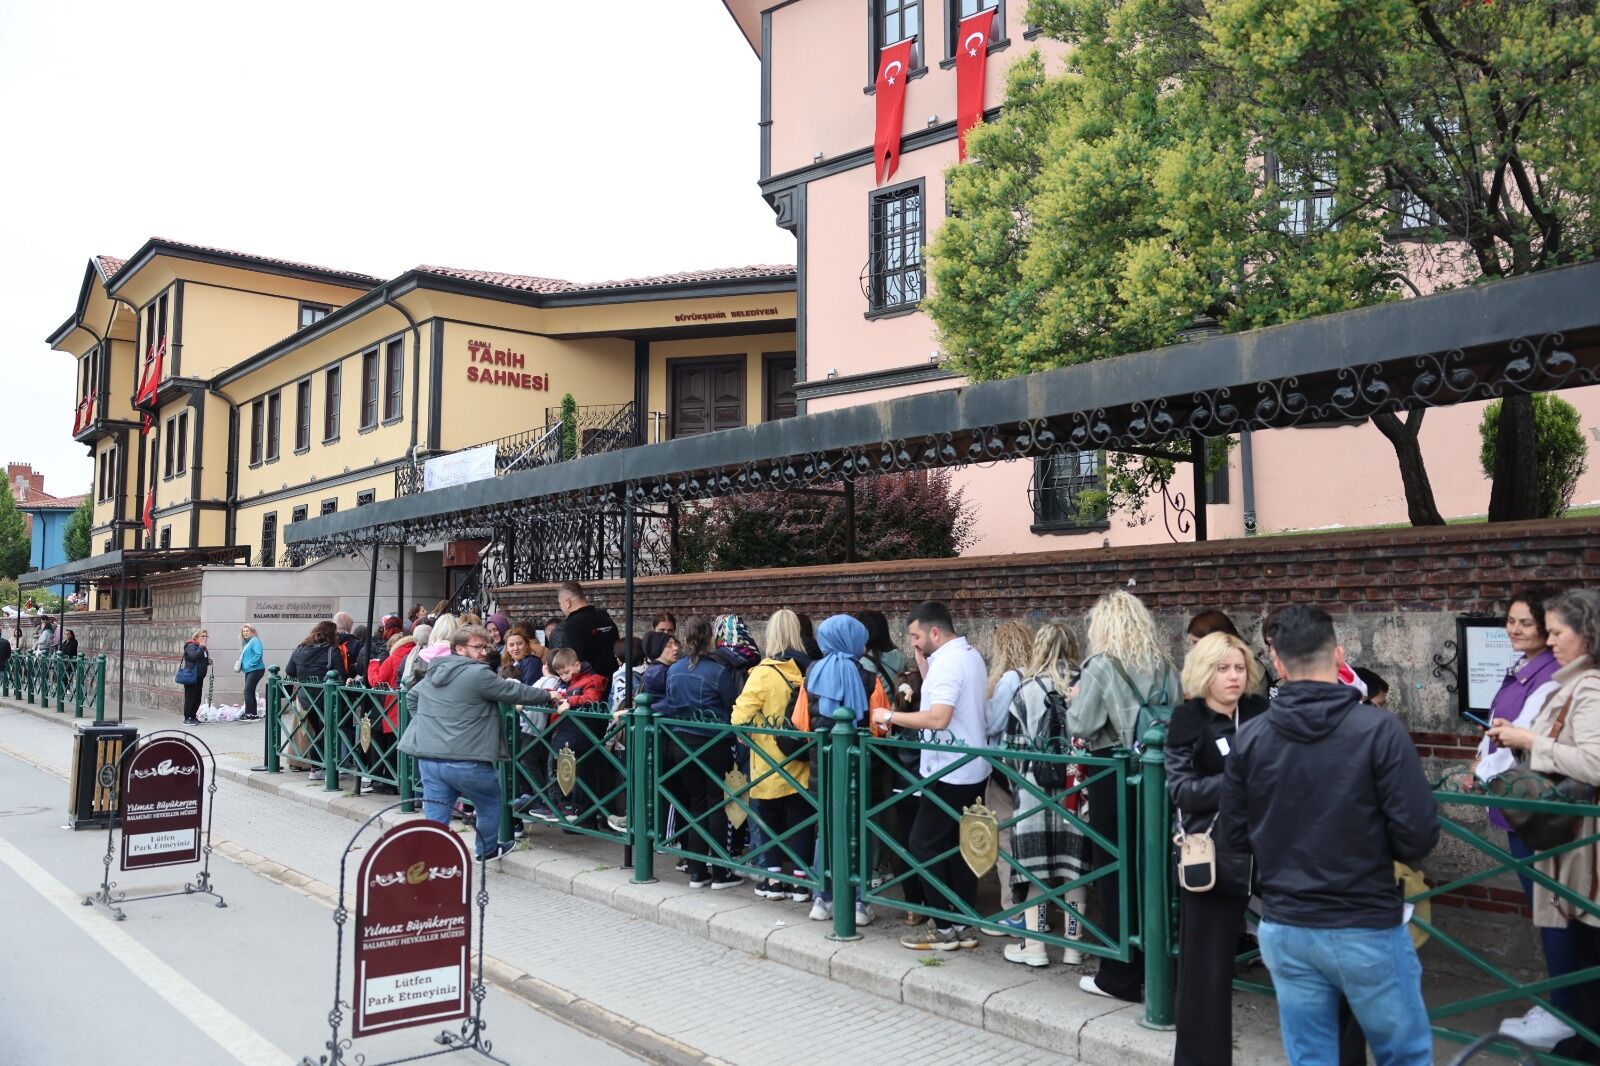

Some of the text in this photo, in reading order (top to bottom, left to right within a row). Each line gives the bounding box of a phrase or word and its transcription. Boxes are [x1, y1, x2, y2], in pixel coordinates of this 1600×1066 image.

[675, 307, 778, 322] BÜYÜKŞEHİR BELEDİYESİ
[468, 339, 491, 348] CANLI
[468, 346, 525, 369] TARİH
[467, 366, 549, 392] SAHNESİ
[127, 800, 197, 812] Yılmaz Büyükerşen
[134, 839, 190, 852] Park Etmeyiniz
[151, 834, 175, 843] Lütfen
[364, 915, 465, 937] Yılmaz Büyükerşen
[363, 929, 465, 951] BALMUMU HEYKELLER MÜZESİ
[395, 975, 432, 989] Lütfen
[368, 985, 457, 1007] Park Etmeyiniz
